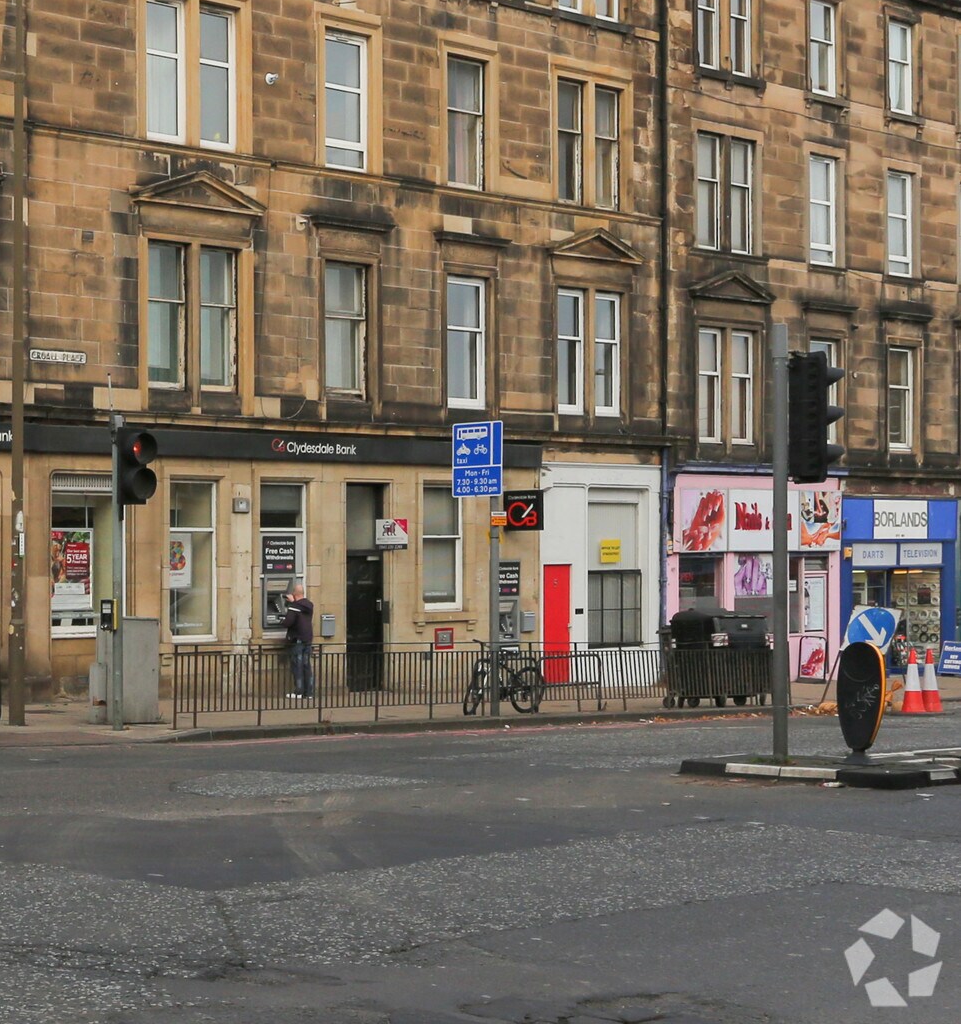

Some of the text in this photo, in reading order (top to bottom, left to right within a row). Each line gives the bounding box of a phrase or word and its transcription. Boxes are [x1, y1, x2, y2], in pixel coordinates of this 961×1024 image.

[32, 351, 84, 362] CROALL PLACE
[287, 441, 334, 455] Clydesdale
[336, 443, 357, 455] Bank
[734, 501, 762, 531] Nails
[874, 511, 928, 527] BORLANDS
[66, 554, 72, 564] 5
[862, 550, 884, 559] DARTS
[903, 549, 938, 558] TELEVISION
